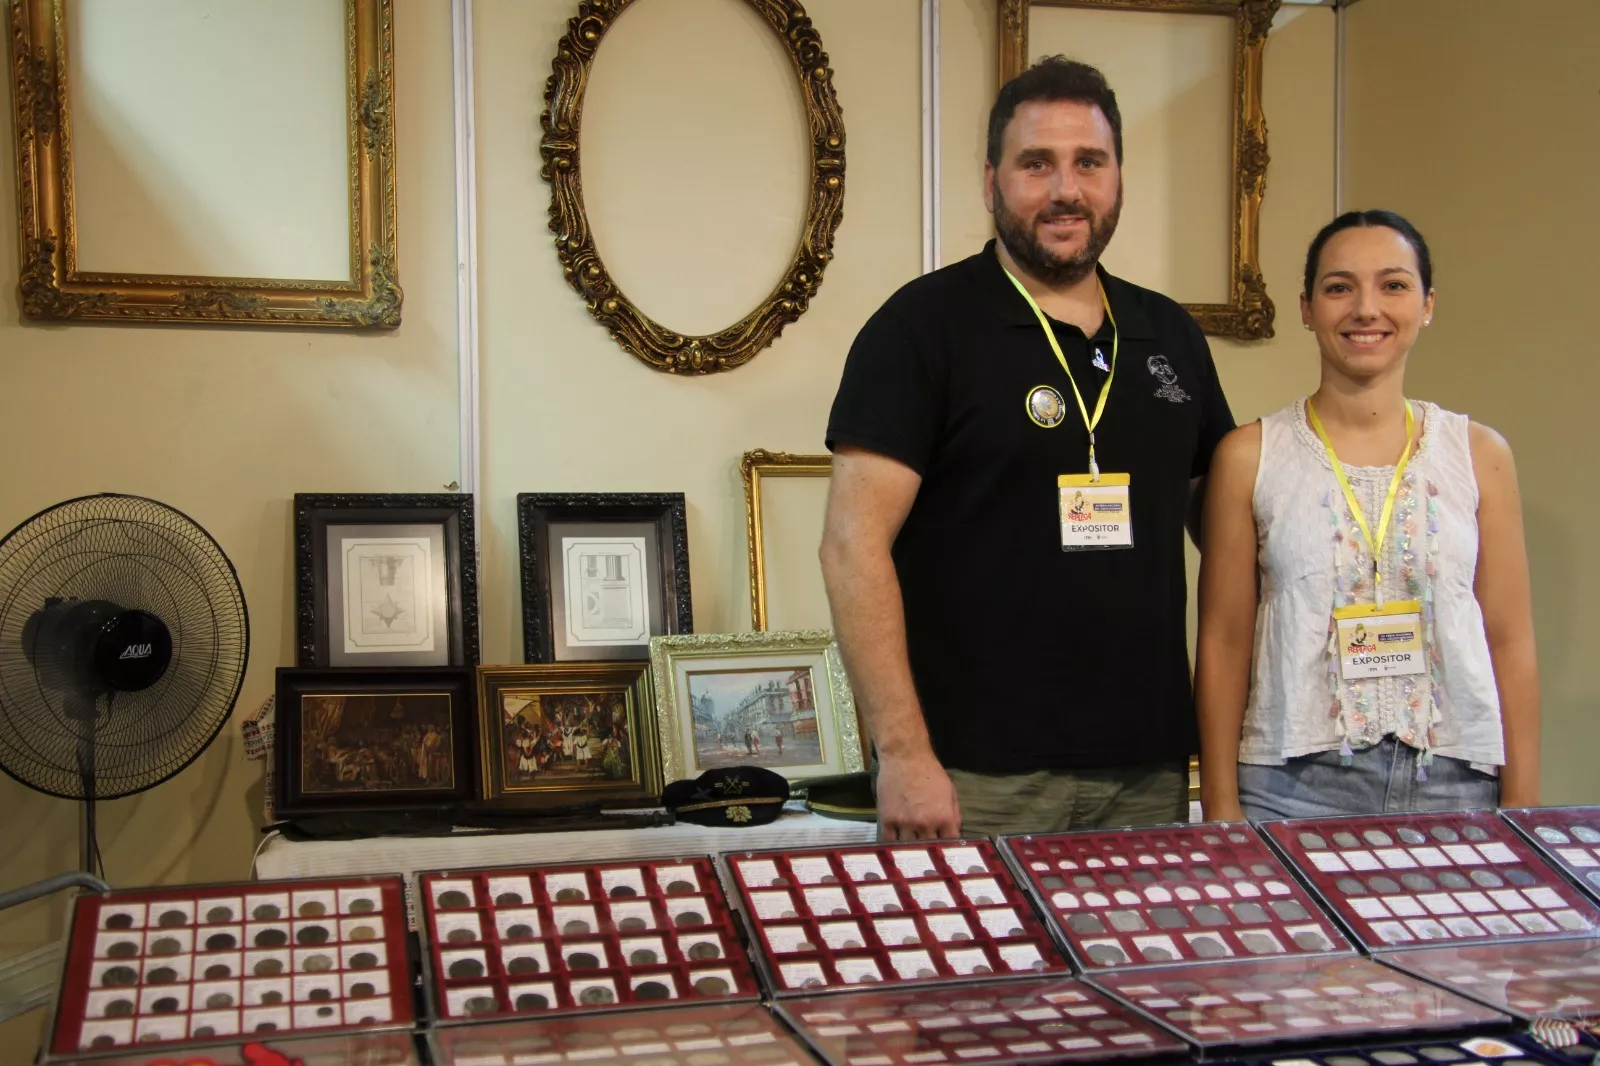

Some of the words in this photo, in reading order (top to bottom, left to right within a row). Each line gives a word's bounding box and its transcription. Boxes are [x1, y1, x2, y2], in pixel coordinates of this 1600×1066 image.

[1071, 524, 1120, 533] EXPOSITOR
[121, 643, 152, 657] AQUA
[1352, 653, 1411, 666] EXPOSITOR
